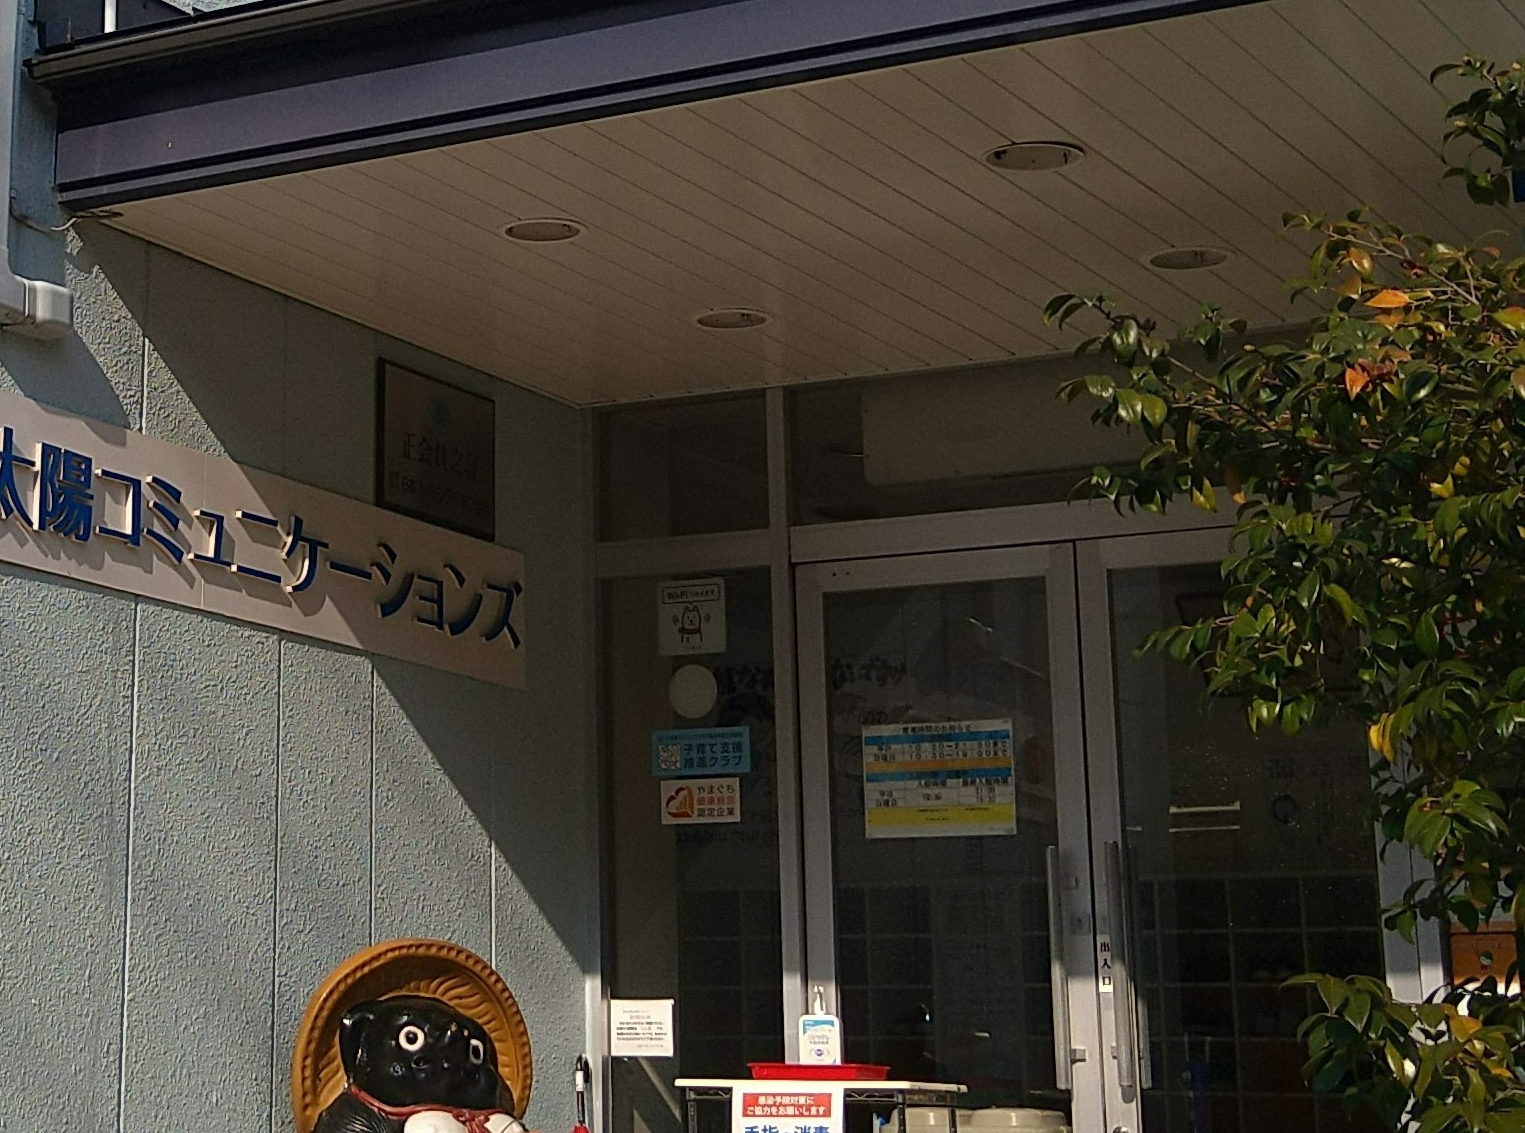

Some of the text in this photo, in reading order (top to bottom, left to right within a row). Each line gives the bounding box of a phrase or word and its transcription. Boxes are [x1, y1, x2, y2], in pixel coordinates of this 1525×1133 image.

[683, 741, 743, 756] 子育て支援
[683, 755, 742, 770] 推進クラブ
[697, 783, 736, 795] やまぐち
[1100, 941, 1112, 987] 出入口
[746, 1105, 826, 1116] ご協力をお願いします
